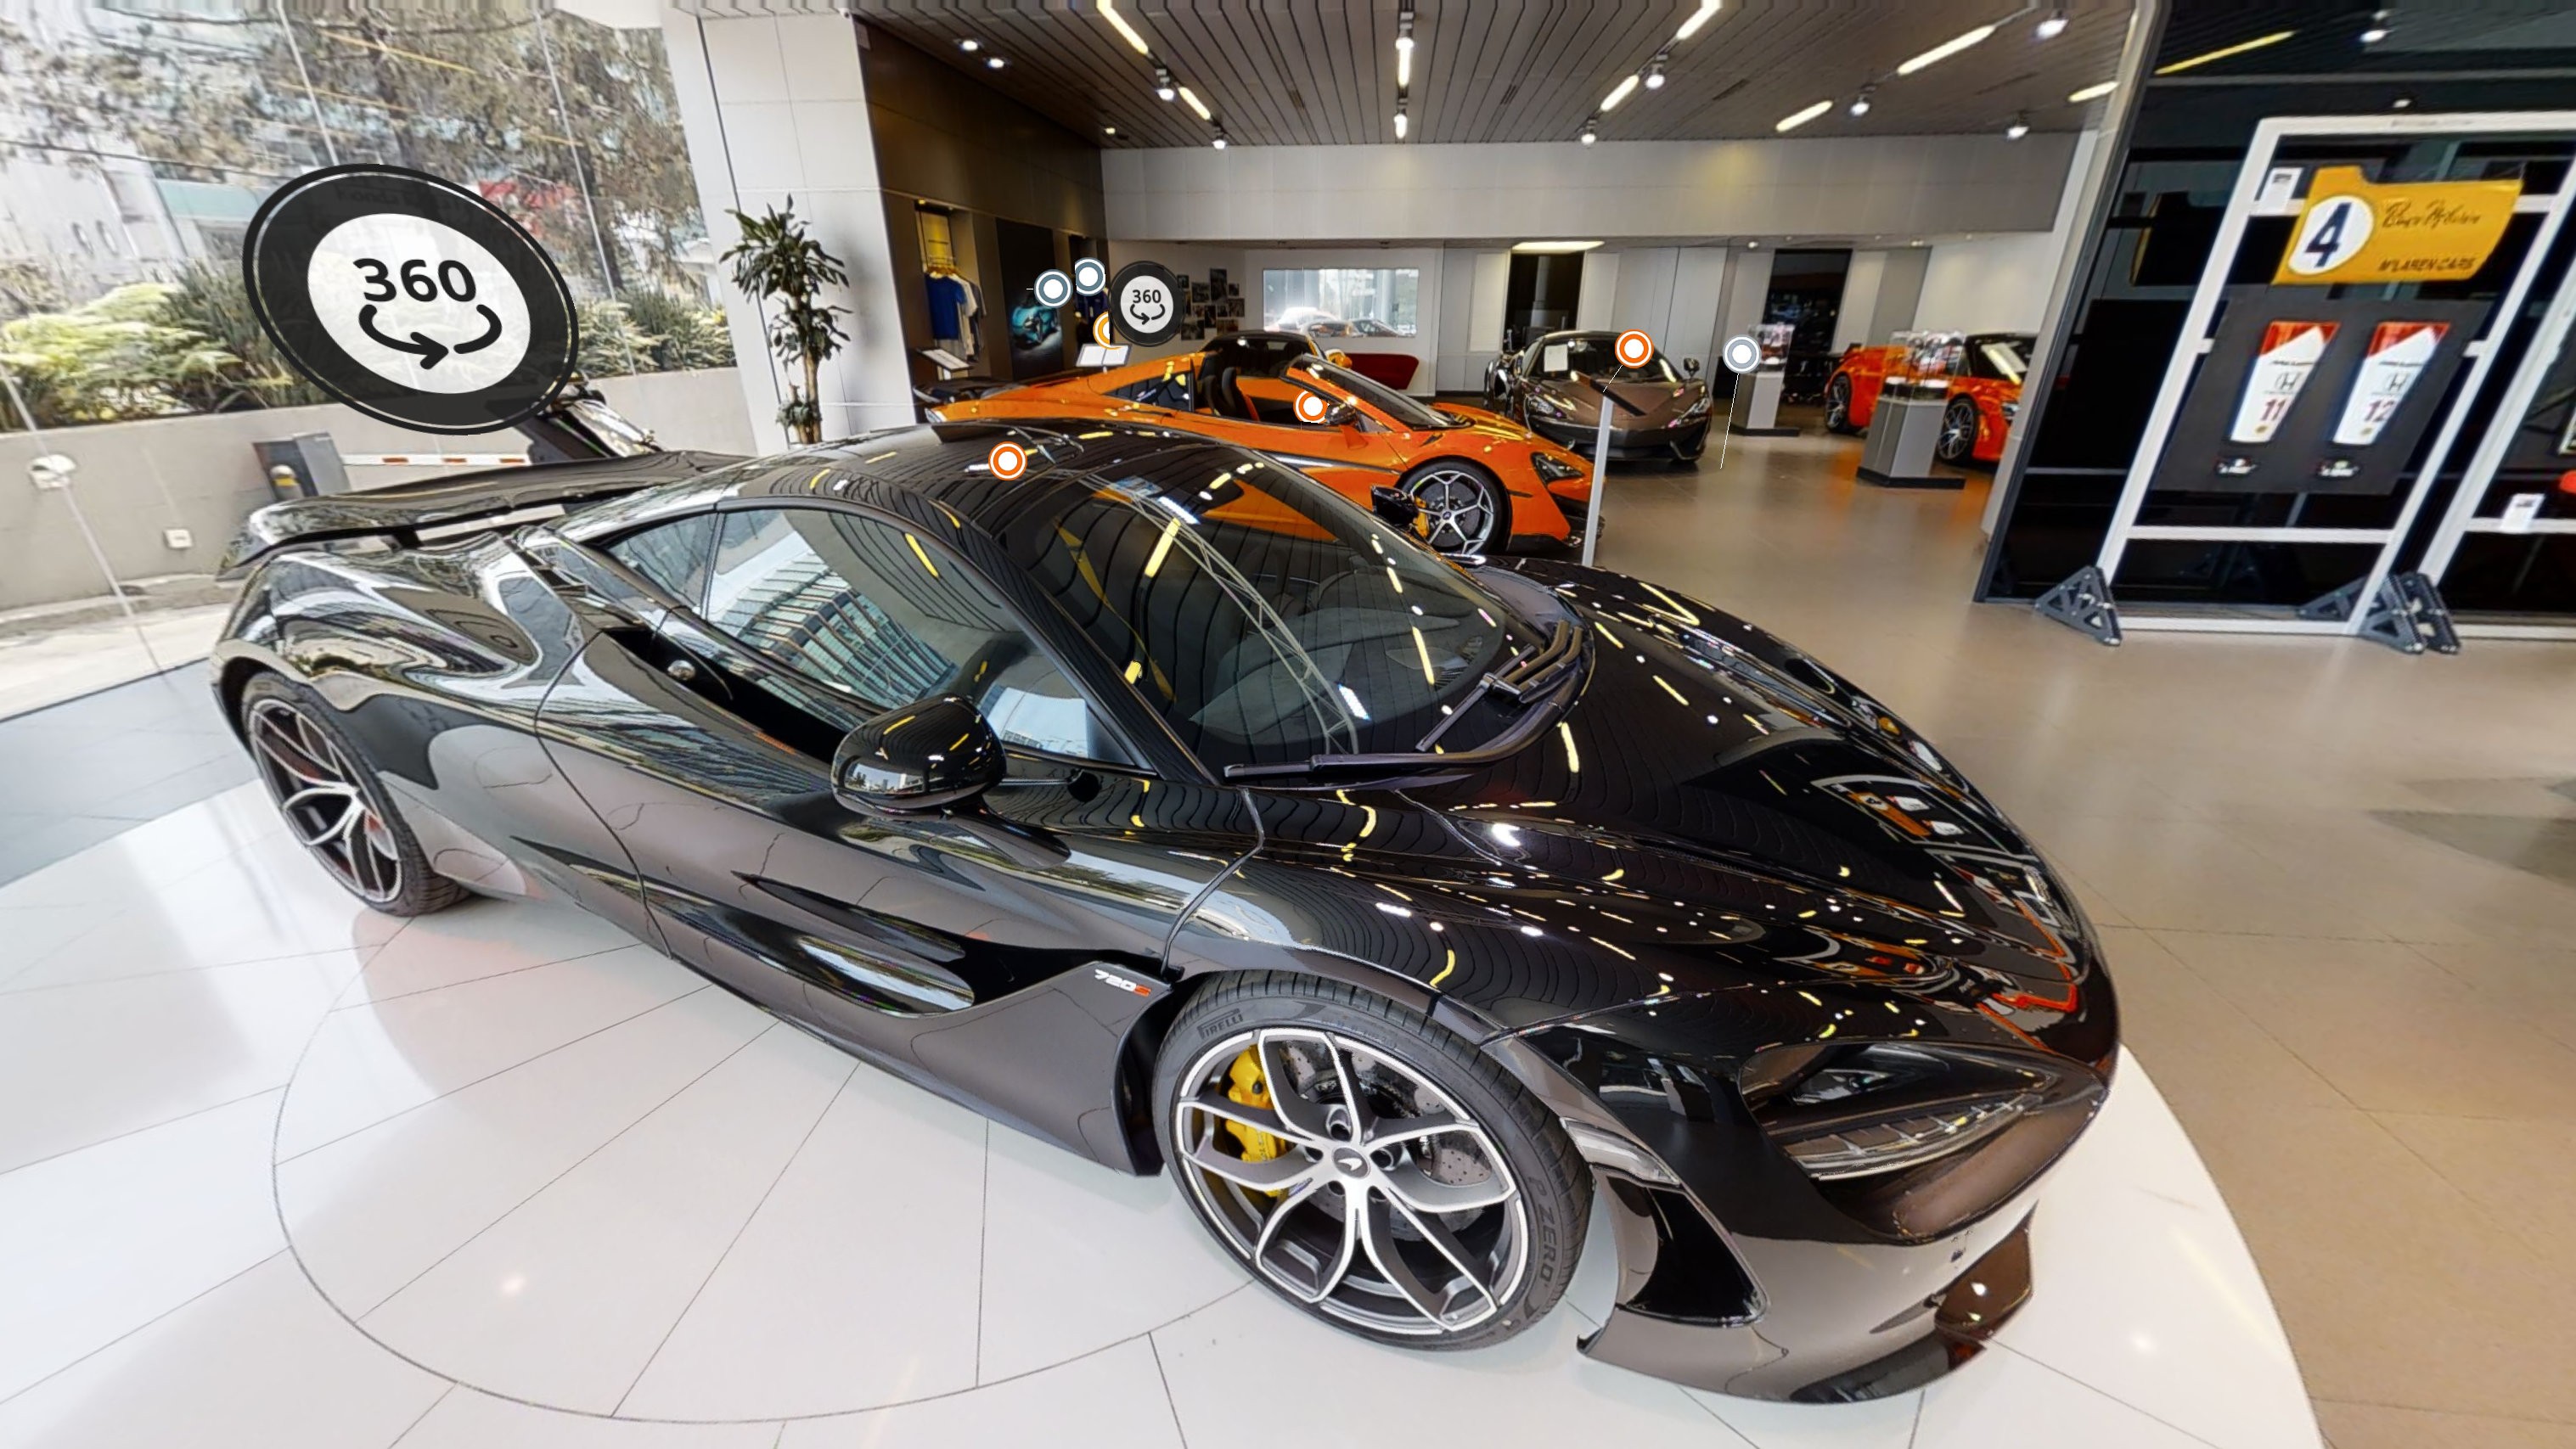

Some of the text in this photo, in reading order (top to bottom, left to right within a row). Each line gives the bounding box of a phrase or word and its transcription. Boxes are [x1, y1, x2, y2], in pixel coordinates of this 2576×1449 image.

[2304, 201, 2353, 268] 4
[2259, 399, 2286, 422] 11
[2364, 399, 2396, 423] 12
[1094, 969, 1151, 997] 720S
[1196, 1008, 1244, 1040] PIRELLI
[1527, 1176, 1558, 1283] P ZERO
